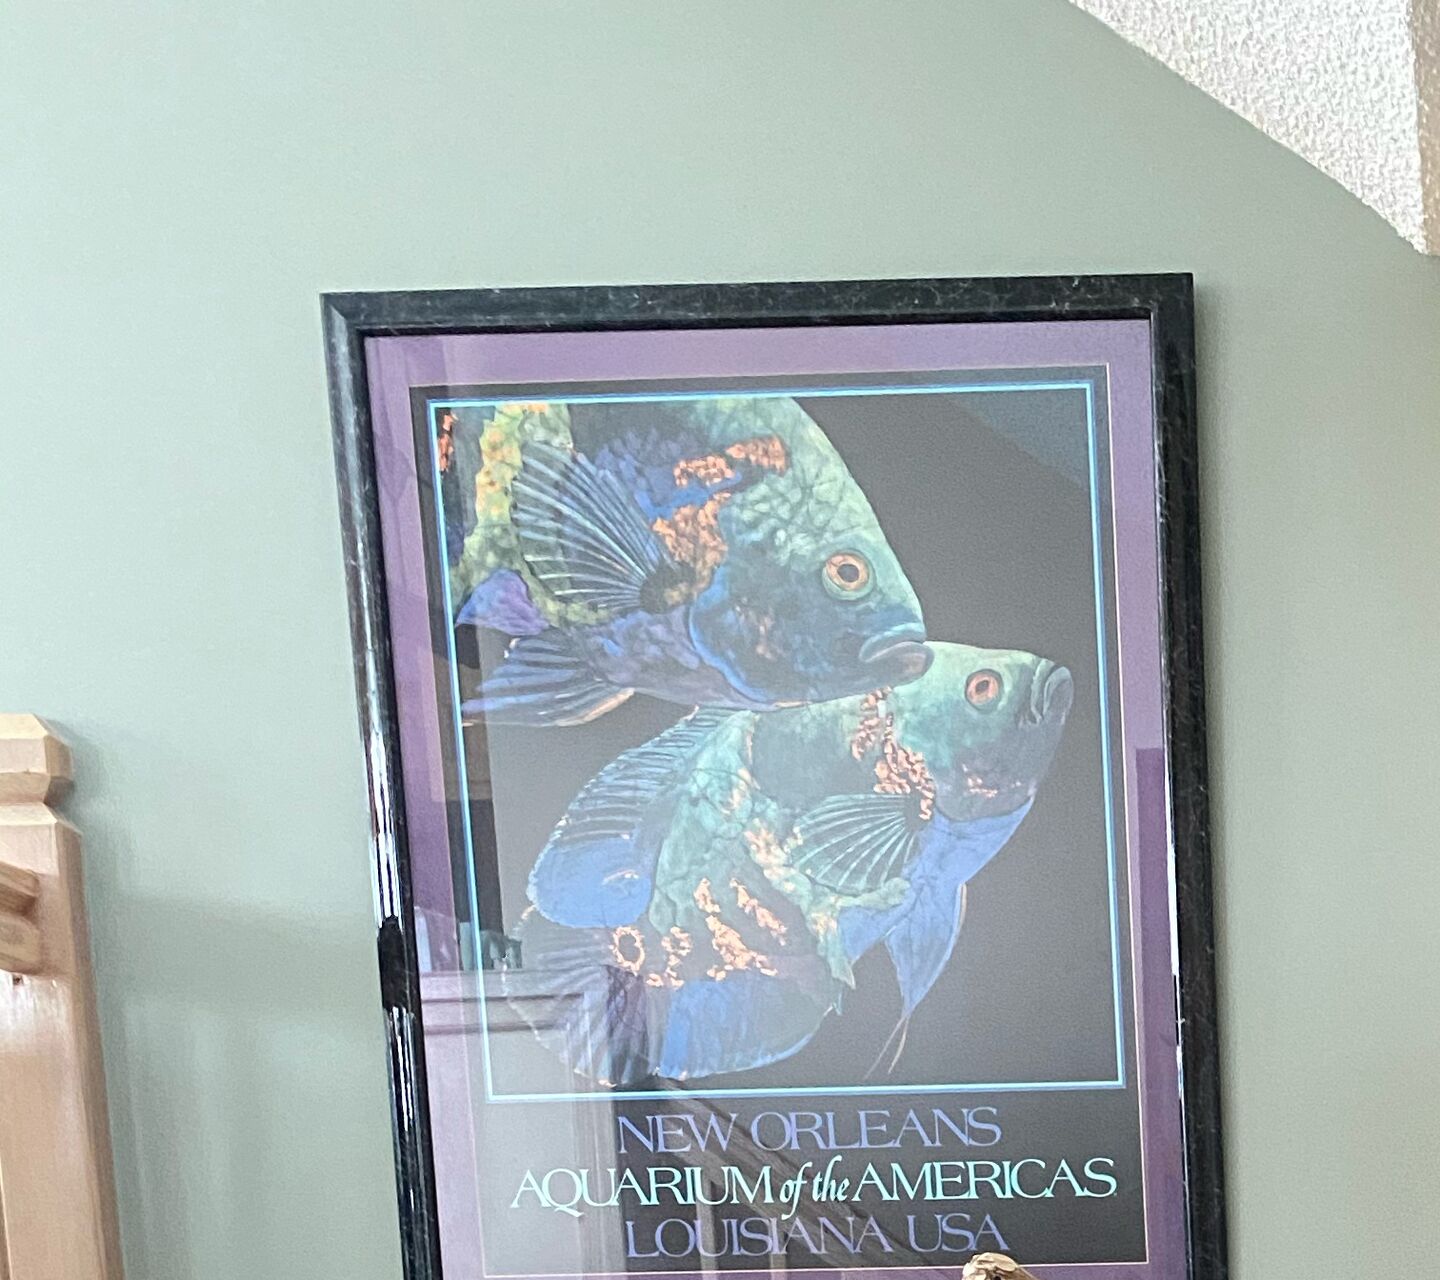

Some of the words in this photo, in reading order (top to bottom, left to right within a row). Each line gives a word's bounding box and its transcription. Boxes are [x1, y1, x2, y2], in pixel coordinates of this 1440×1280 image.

[617, 1113, 739, 1155] NEW
[750, 1105, 1002, 1152] ORLEANS
[510, 1164, 774, 1218] AQUARIUM
[778, 1157, 810, 1221] of
[811, 1155, 850, 1202] the
[852, 1157, 1118, 1202] AMERICAS
[626, 1216, 894, 1259] LOUISIANA
[907, 1211, 1009, 1253] USA
